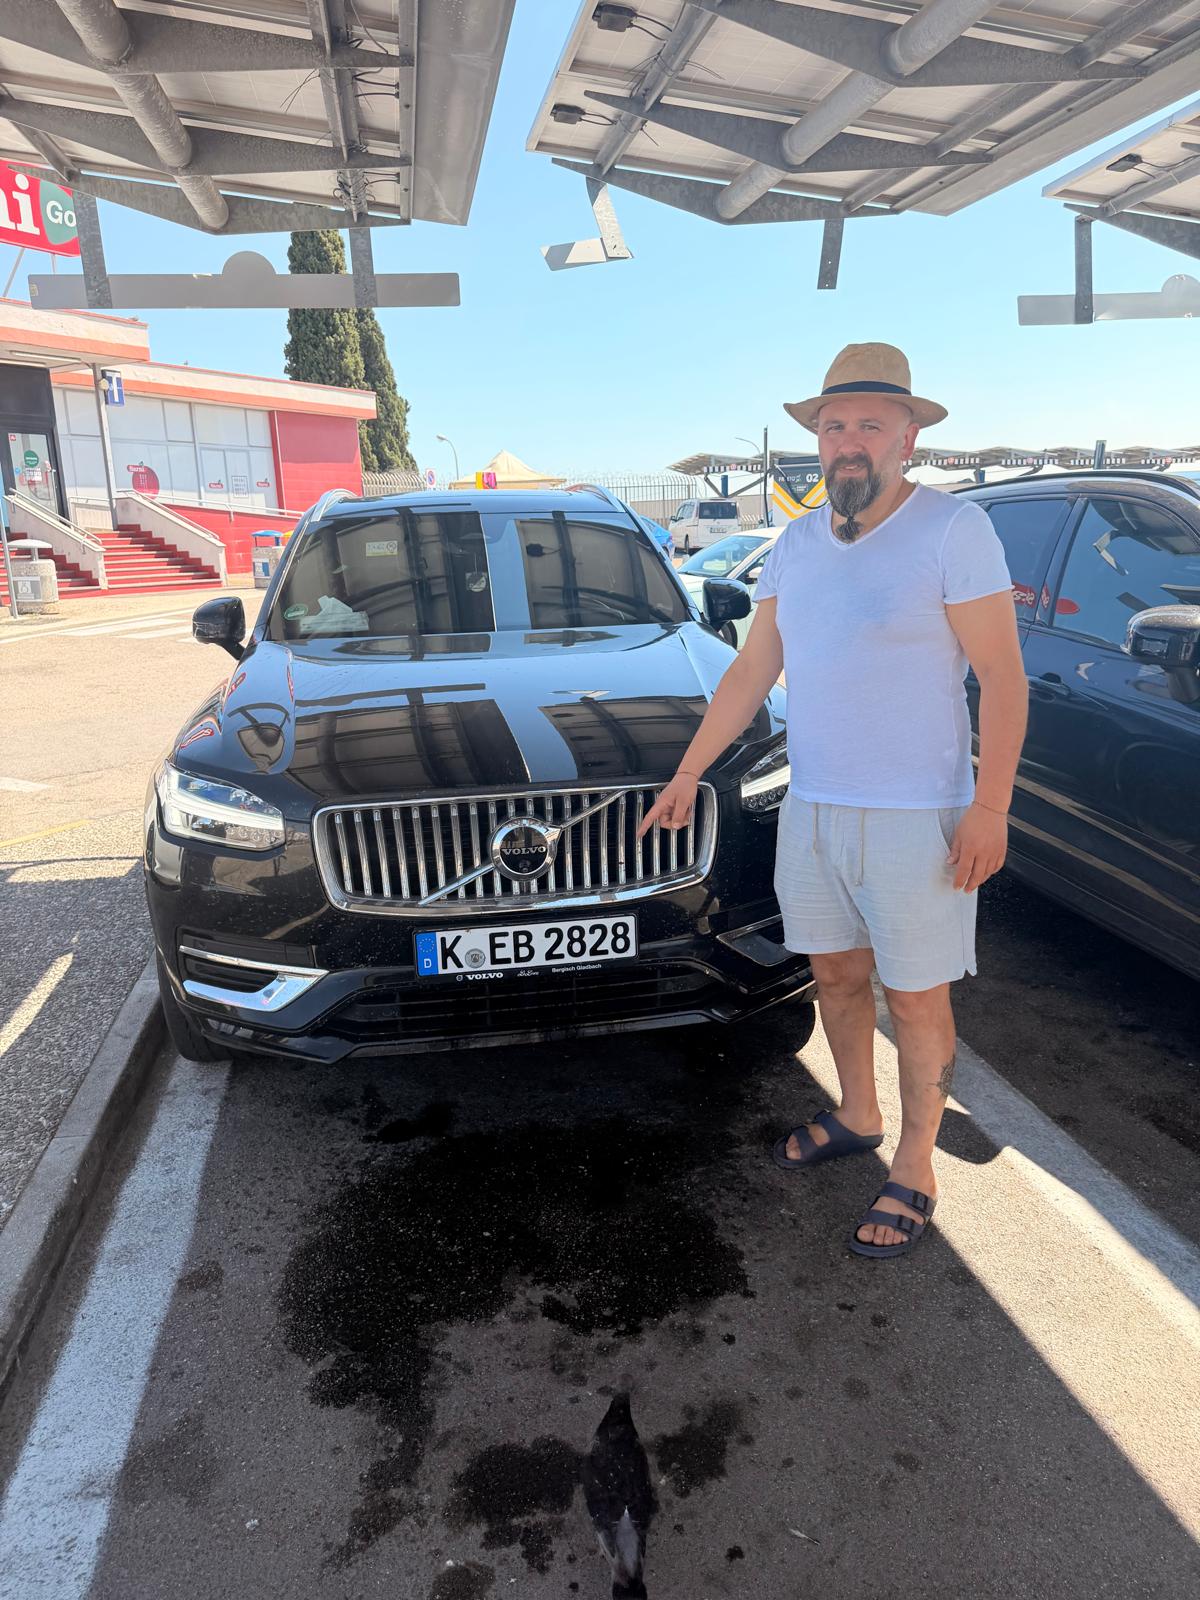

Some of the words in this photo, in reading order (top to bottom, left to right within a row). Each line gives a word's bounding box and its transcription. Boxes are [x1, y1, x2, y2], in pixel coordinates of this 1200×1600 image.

[46, 200, 77, 228] Go
[805, 473, 819, 483] 02
[500, 846, 547, 855] VOLVO
[440, 934, 464, 970] K
[488, 929, 536, 965] EB
[544, 921, 631, 961] 2828
[423, 958, 433, 969] D
[551, 964, 576, 974] Bergisch
[576, 963, 602, 971] Gladbach
[465, 971, 504, 981] VOLVO
